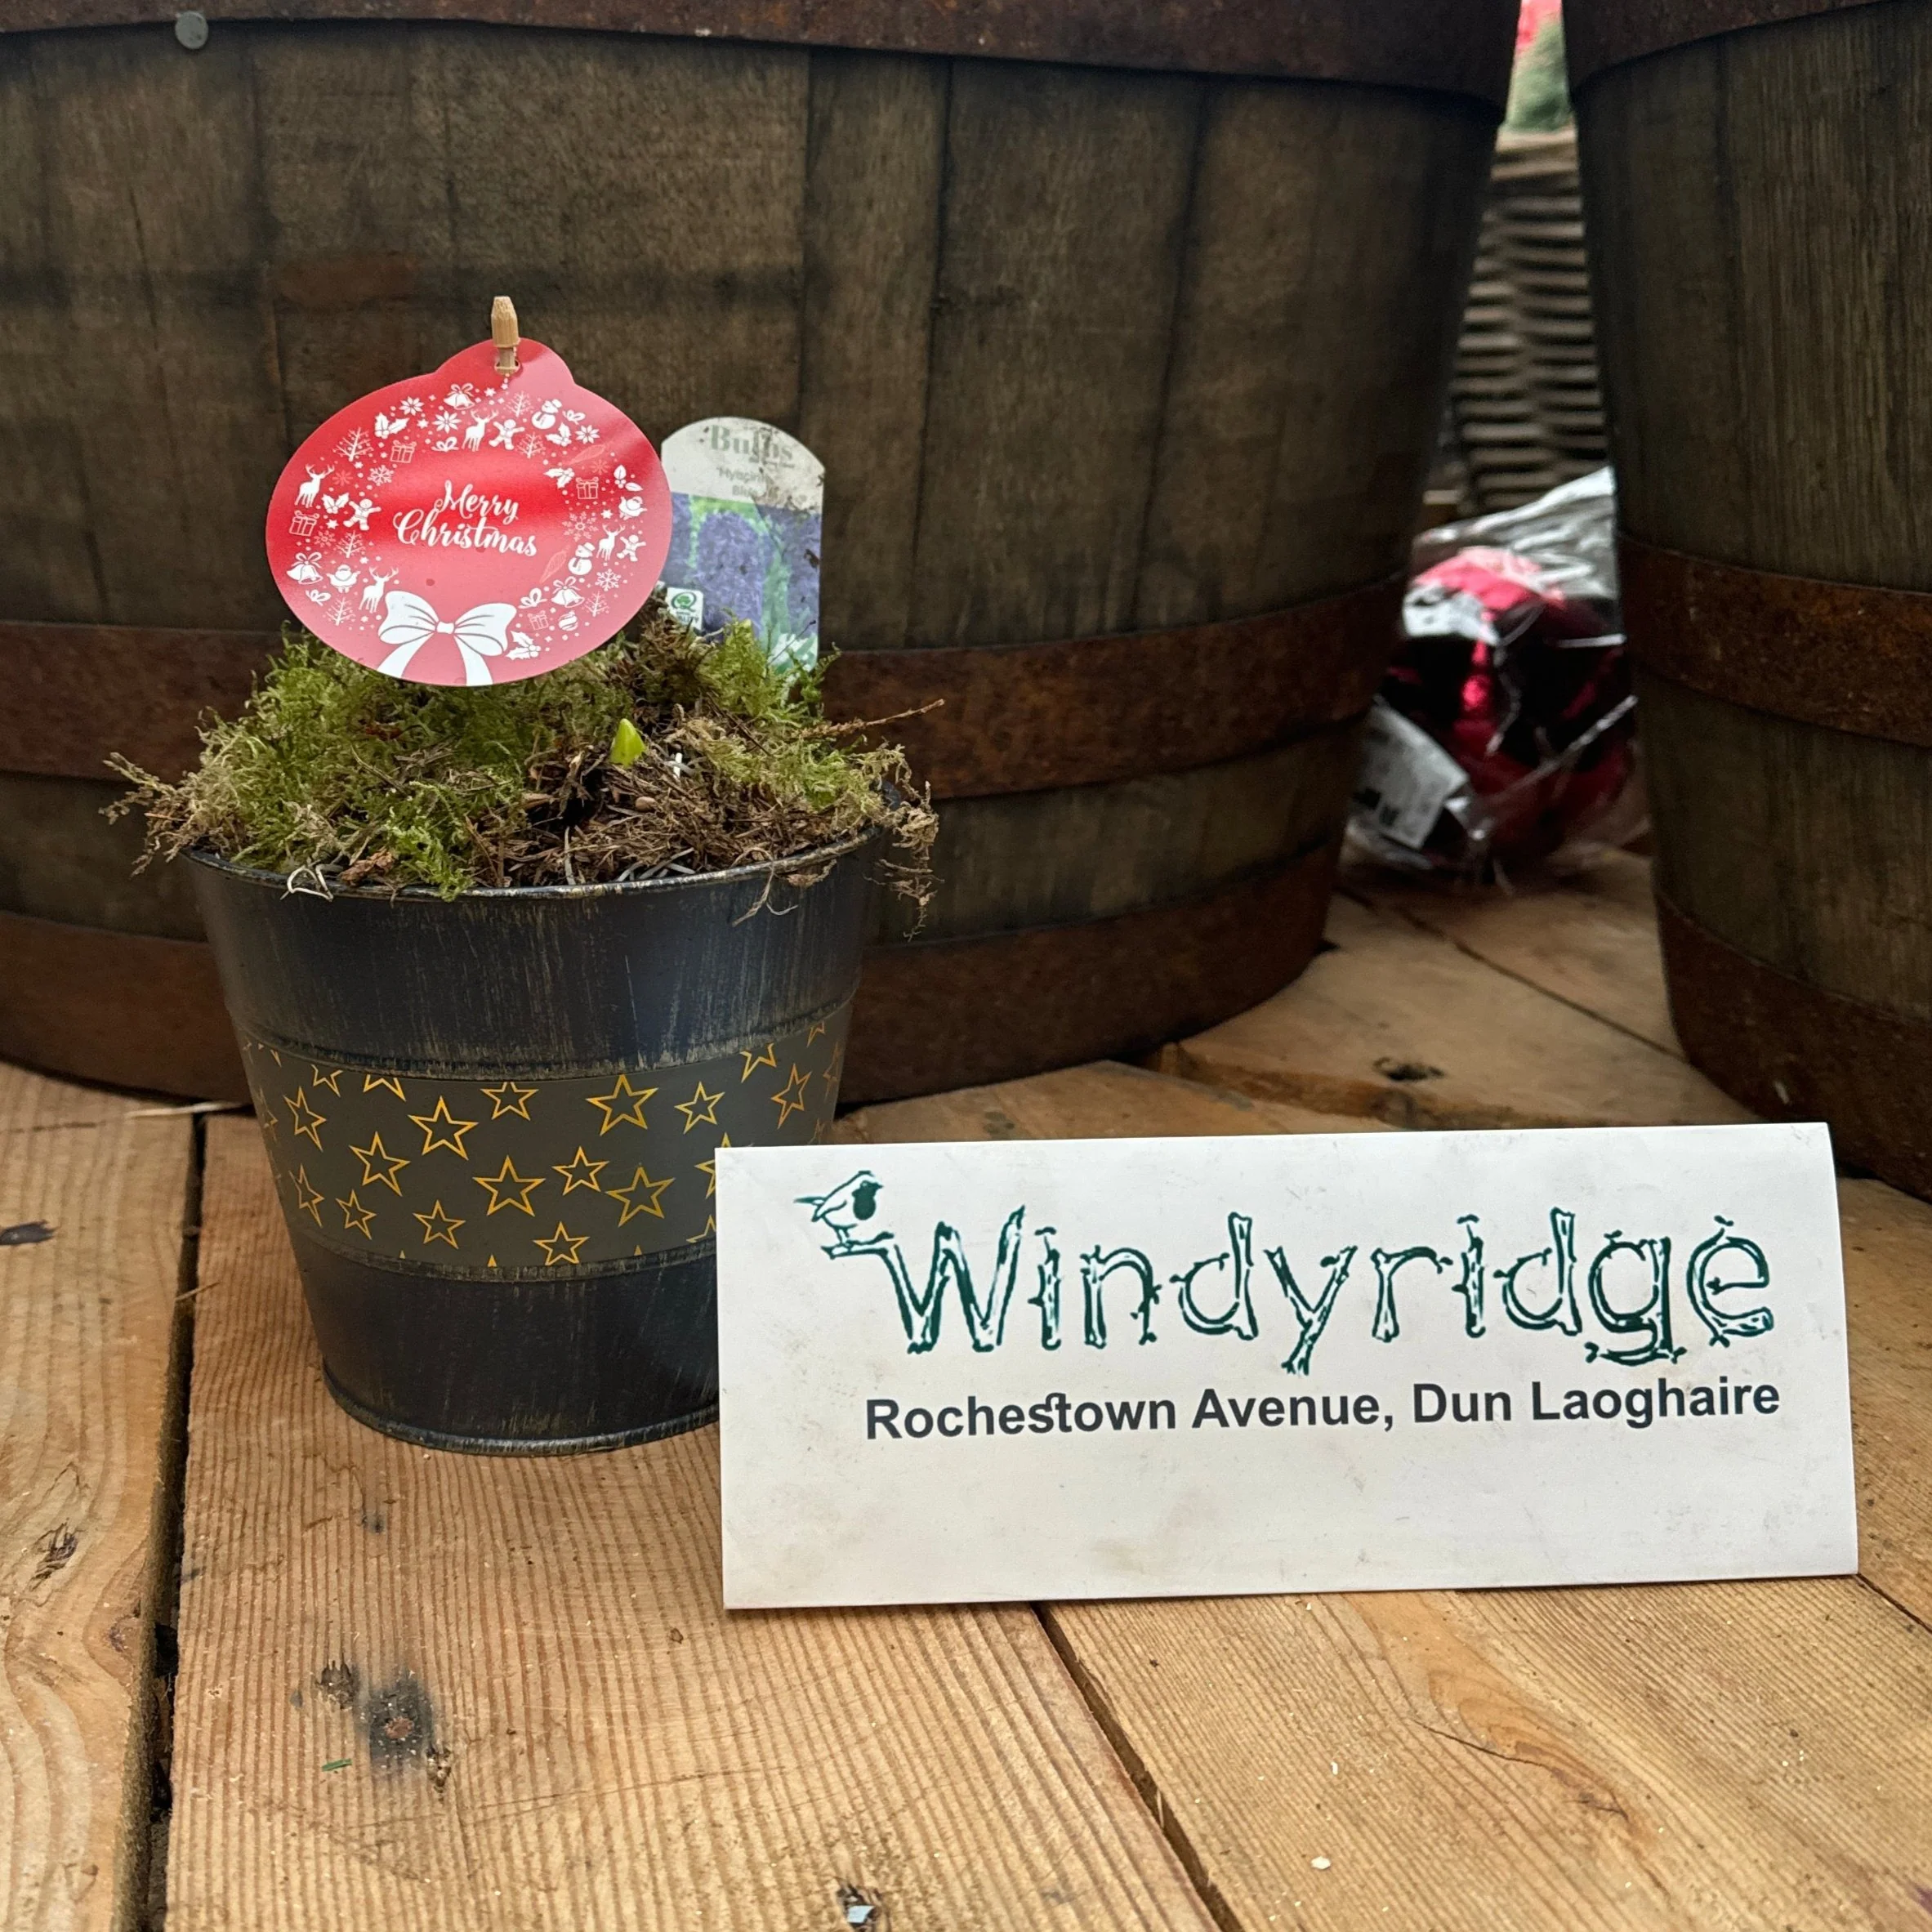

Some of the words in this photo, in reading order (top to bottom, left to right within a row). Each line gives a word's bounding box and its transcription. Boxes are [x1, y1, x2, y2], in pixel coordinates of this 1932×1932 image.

[434, 480, 520, 525] Merry
[393, 507, 538, 557] Christmas
[821, 1205, 1775, 1376] Windyridge
[866, 1392, 1176, 1440] Rochestown
[1191, 1388, 1394, 1432] Avenue,
[1412, 1382, 1512, 1423] Dun
[1531, 1376, 1781, 1429] Laoghaire
